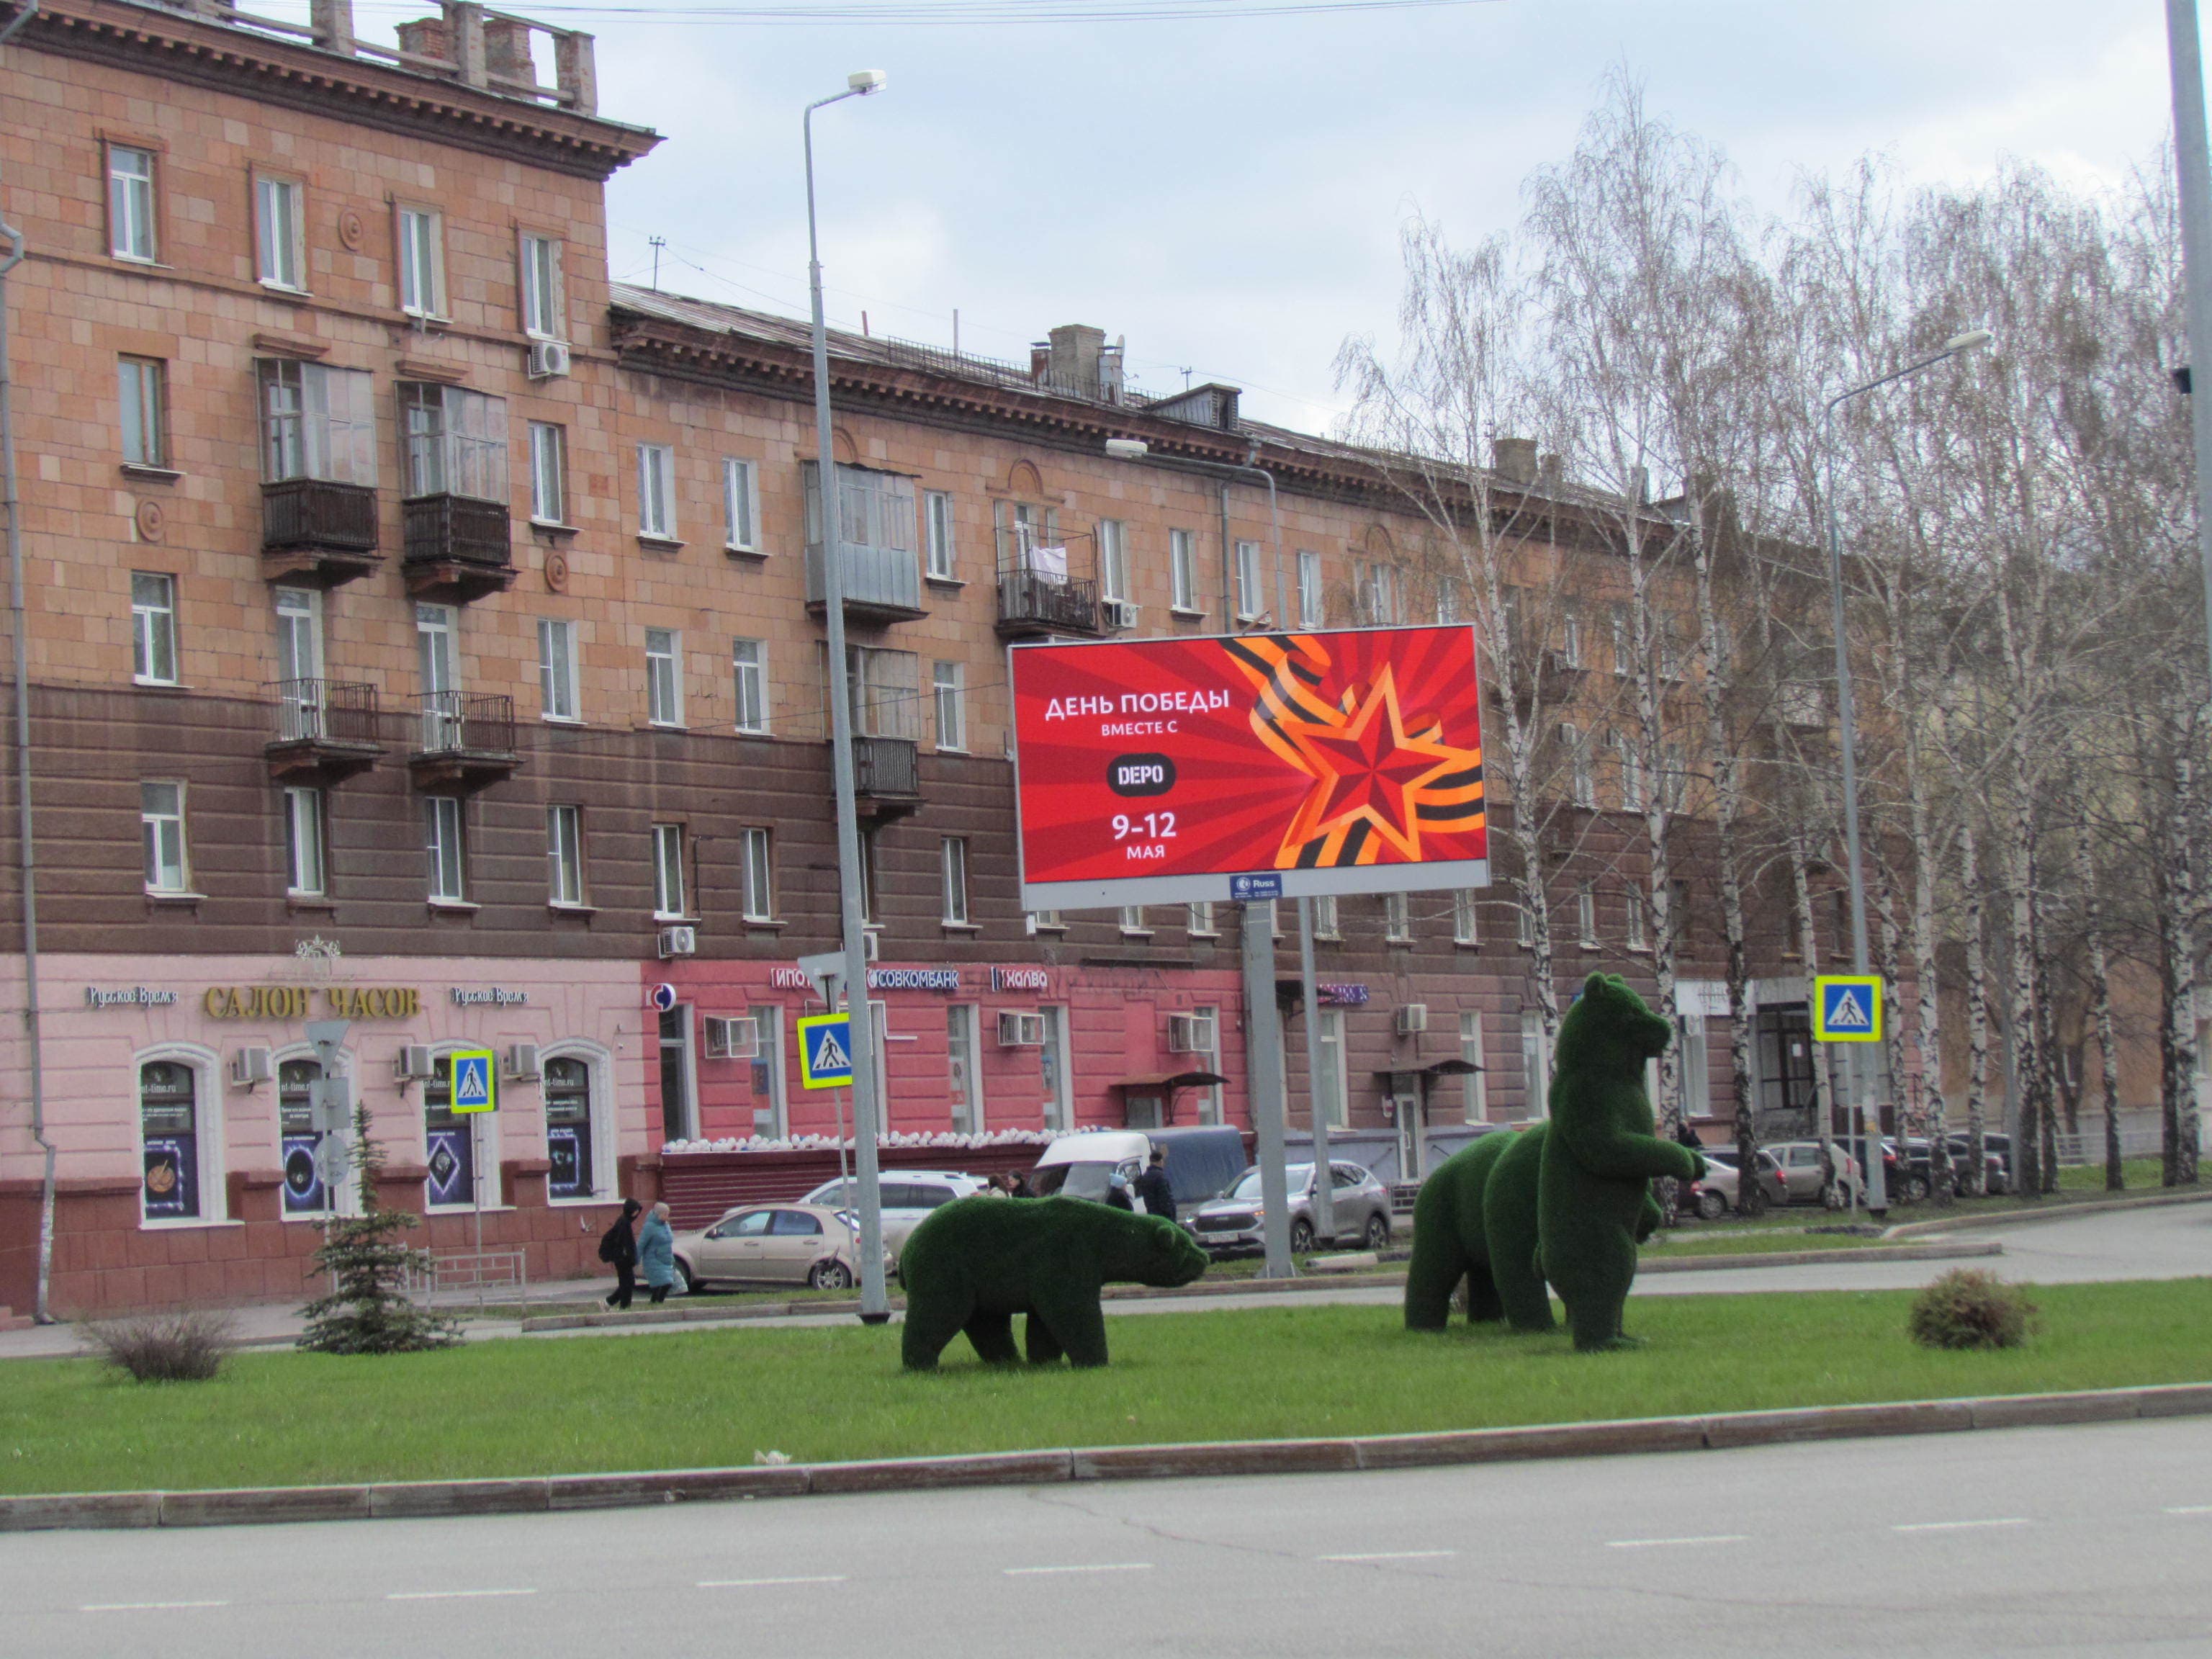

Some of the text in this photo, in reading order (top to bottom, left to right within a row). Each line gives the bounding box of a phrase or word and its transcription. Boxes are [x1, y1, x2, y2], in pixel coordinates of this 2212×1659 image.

[1046, 689, 1229, 721] ДЕНЬ ПОБЕДЫ
[1101, 721, 1178, 737] ВМЕСТЕ С
[1118, 765, 1164, 785] DEPO
[1112, 811, 1177, 840] 9-12
[1126, 844, 1165, 860] МАЯ
[1253, 880, 1275, 889] Russ
[878, 969, 959, 988] СОВКОМБАНК
[89, 986, 179, 1008] Русское Время
[205, 986, 421, 1018] САЛОН ЧАСОВ
[454, 986, 530, 1007] Русское Время
